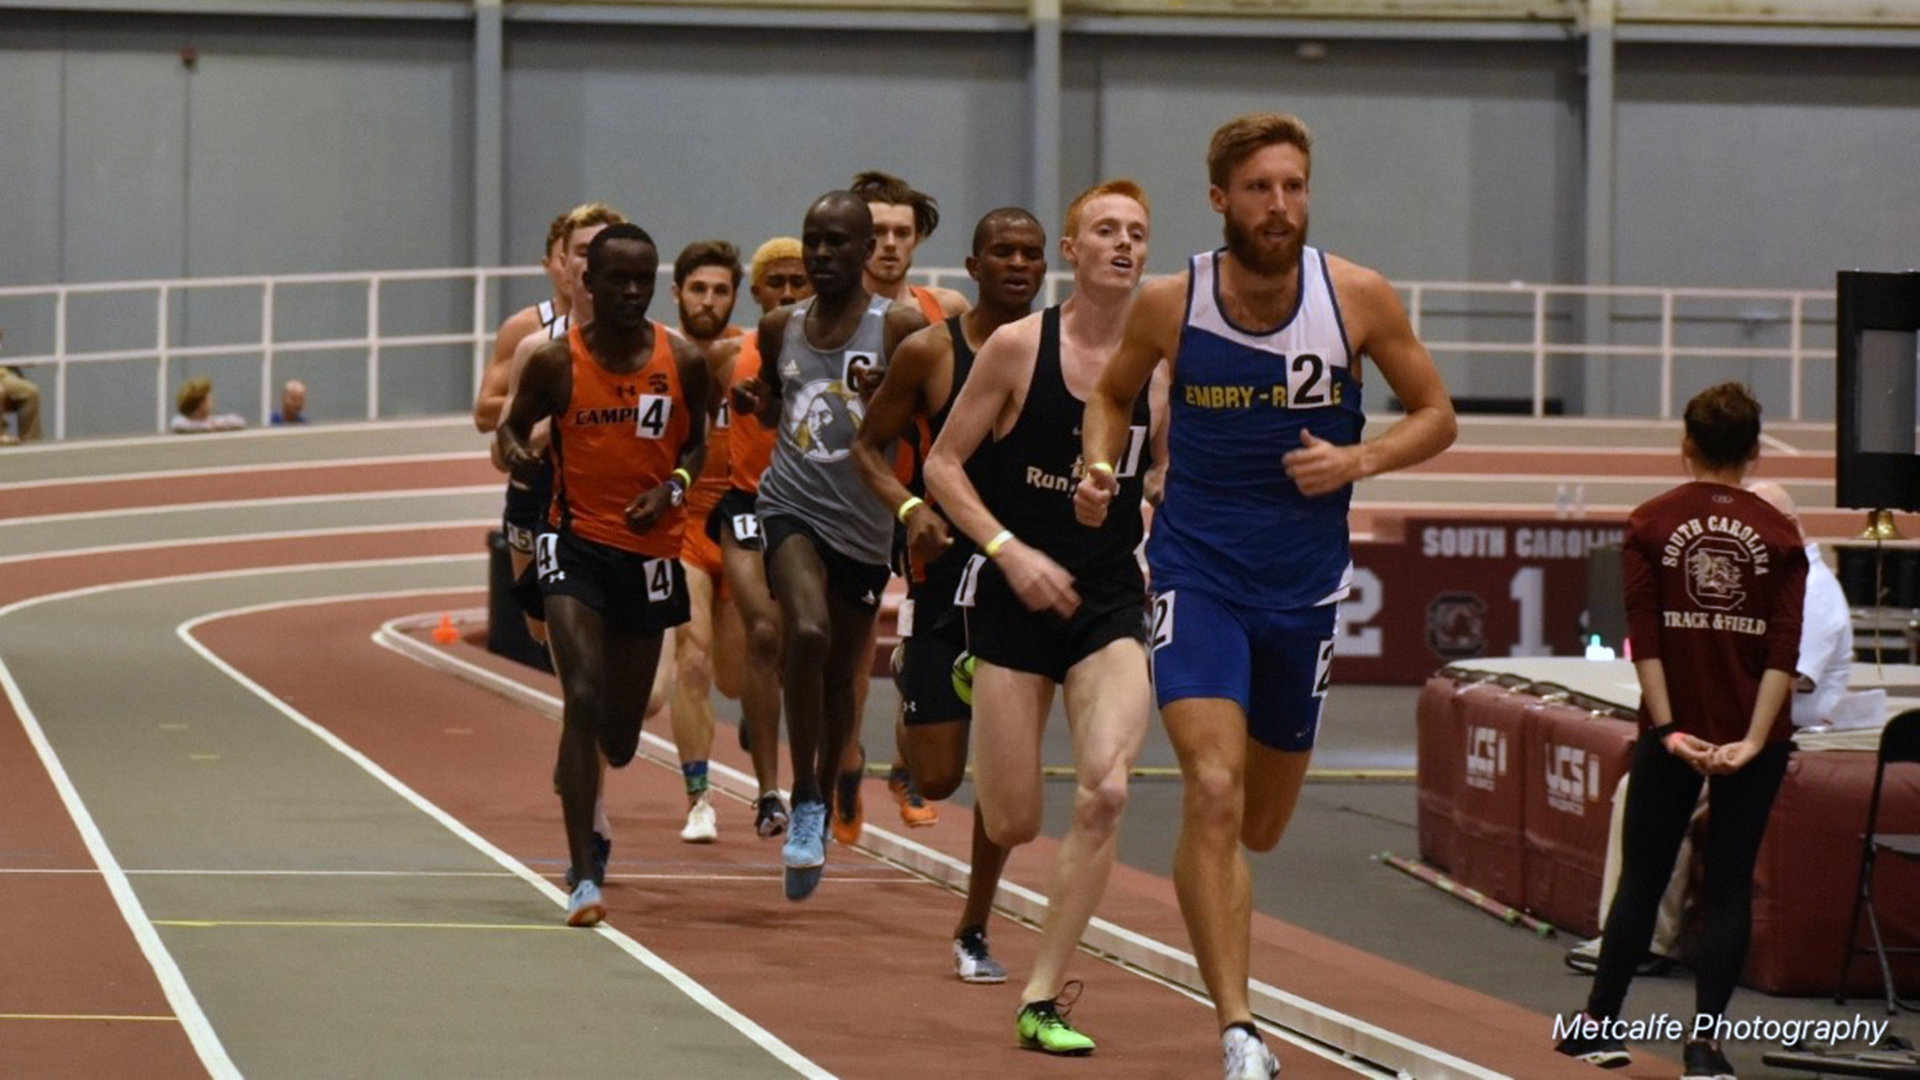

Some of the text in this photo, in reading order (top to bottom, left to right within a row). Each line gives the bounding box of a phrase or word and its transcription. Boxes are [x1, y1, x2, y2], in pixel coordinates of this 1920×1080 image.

[1185, 383, 1343, 409] EMBRY-RE
[1292, 353, 1326, 405] 2
[641, 398, 665, 436] 4
[540, 536, 552, 571] 4
[1422, 526, 1507, 558] SOUTH
[1661, 515, 1769, 576] SOUTH CAROLINA
[651, 560, 670, 596] 4
[1510, 567, 1553, 657] 1
[1663, 611, 1710, 629] TRACK
